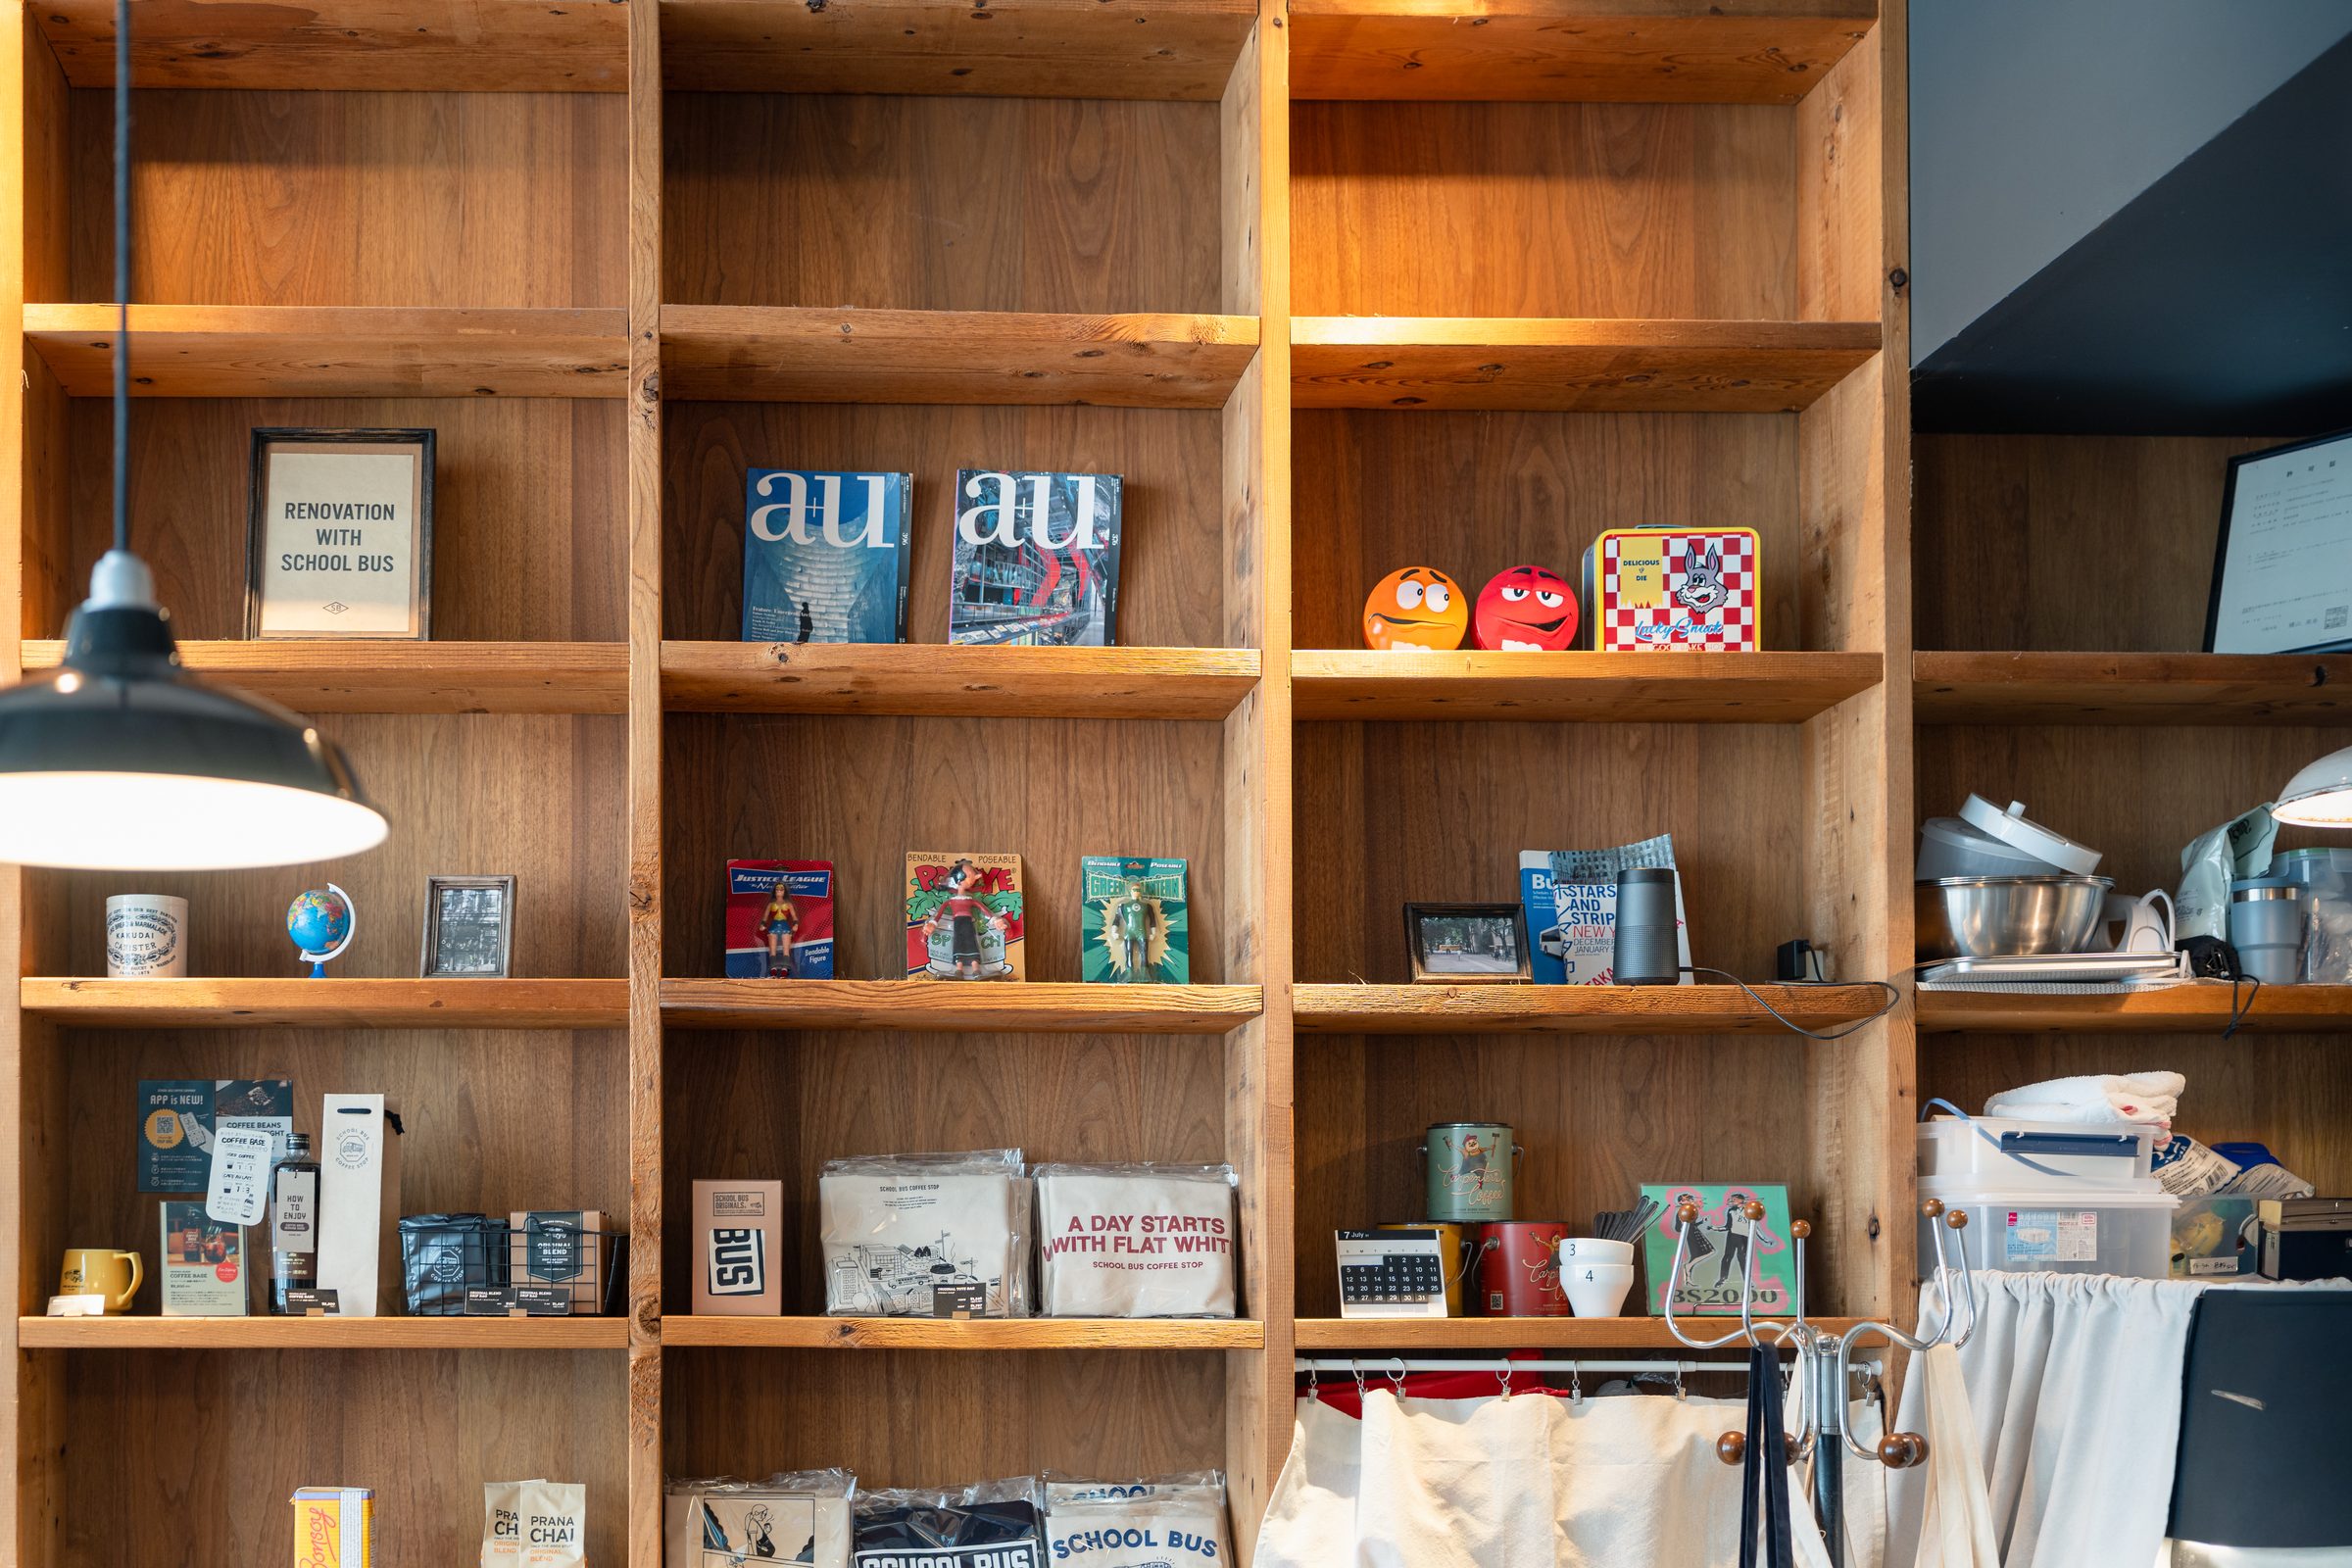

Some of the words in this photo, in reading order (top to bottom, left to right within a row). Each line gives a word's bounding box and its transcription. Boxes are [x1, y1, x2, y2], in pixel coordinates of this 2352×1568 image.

[284, 503, 395, 520] RENOVATION
[316, 529, 362, 546] WITH
[281, 554, 352, 571] SCHOOL
[358, 556, 394, 572] BUS
[1635, 620, 1676, 642] Lucky
[907, 854, 947, 862] BENDABLE
[782, 874, 826, 883] LEAGUE
[1568, 885, 1616, 898] STARS
[1570, 899, 1600, 911] AND
[1573, 926, 1606, 938] NEW
[150, 1095, 169, 1104] APP
[171, 1095, 178, 1104] is
[179, 1095, 204, 1104] NEW!
[336, 1128, 358, 1141] SCHOOL
[360, 1130, 369, 1141] BUS
[335, 1157, 355, 1170] COFFEE
[357, 1157, 369, 1168] STOP
[1451, 1183, 1504, 1205] Coffee
[1068, 1216, 1084, 1233] A
[1091, 1215, 1134, 1232] DAY
[1141, 1215, 1225, 1235] STARTS
[1053, 1236, 1106, 1253] WITH
[1113, 1237, 1167, 1253] FLAT
[1570, 1244, 1576, 1256] 3
[713, 1229, 754, 1286] BUS
[1093, 1261, 1126, 1270] SCHOOL
[1147, 1261, 1178, 1270] COFFEE
[1181, 1260, 1203, 1269] STOP
[1586, 1270, 1593, 1282] 4
[531, 1516, 574, 1526] PRANA
[530, 1528, 574, 1543] CHAI
[1054, 1529, 1158, 1559] SCHOOL
[1168, 1530, 1218, 1557] BUS
